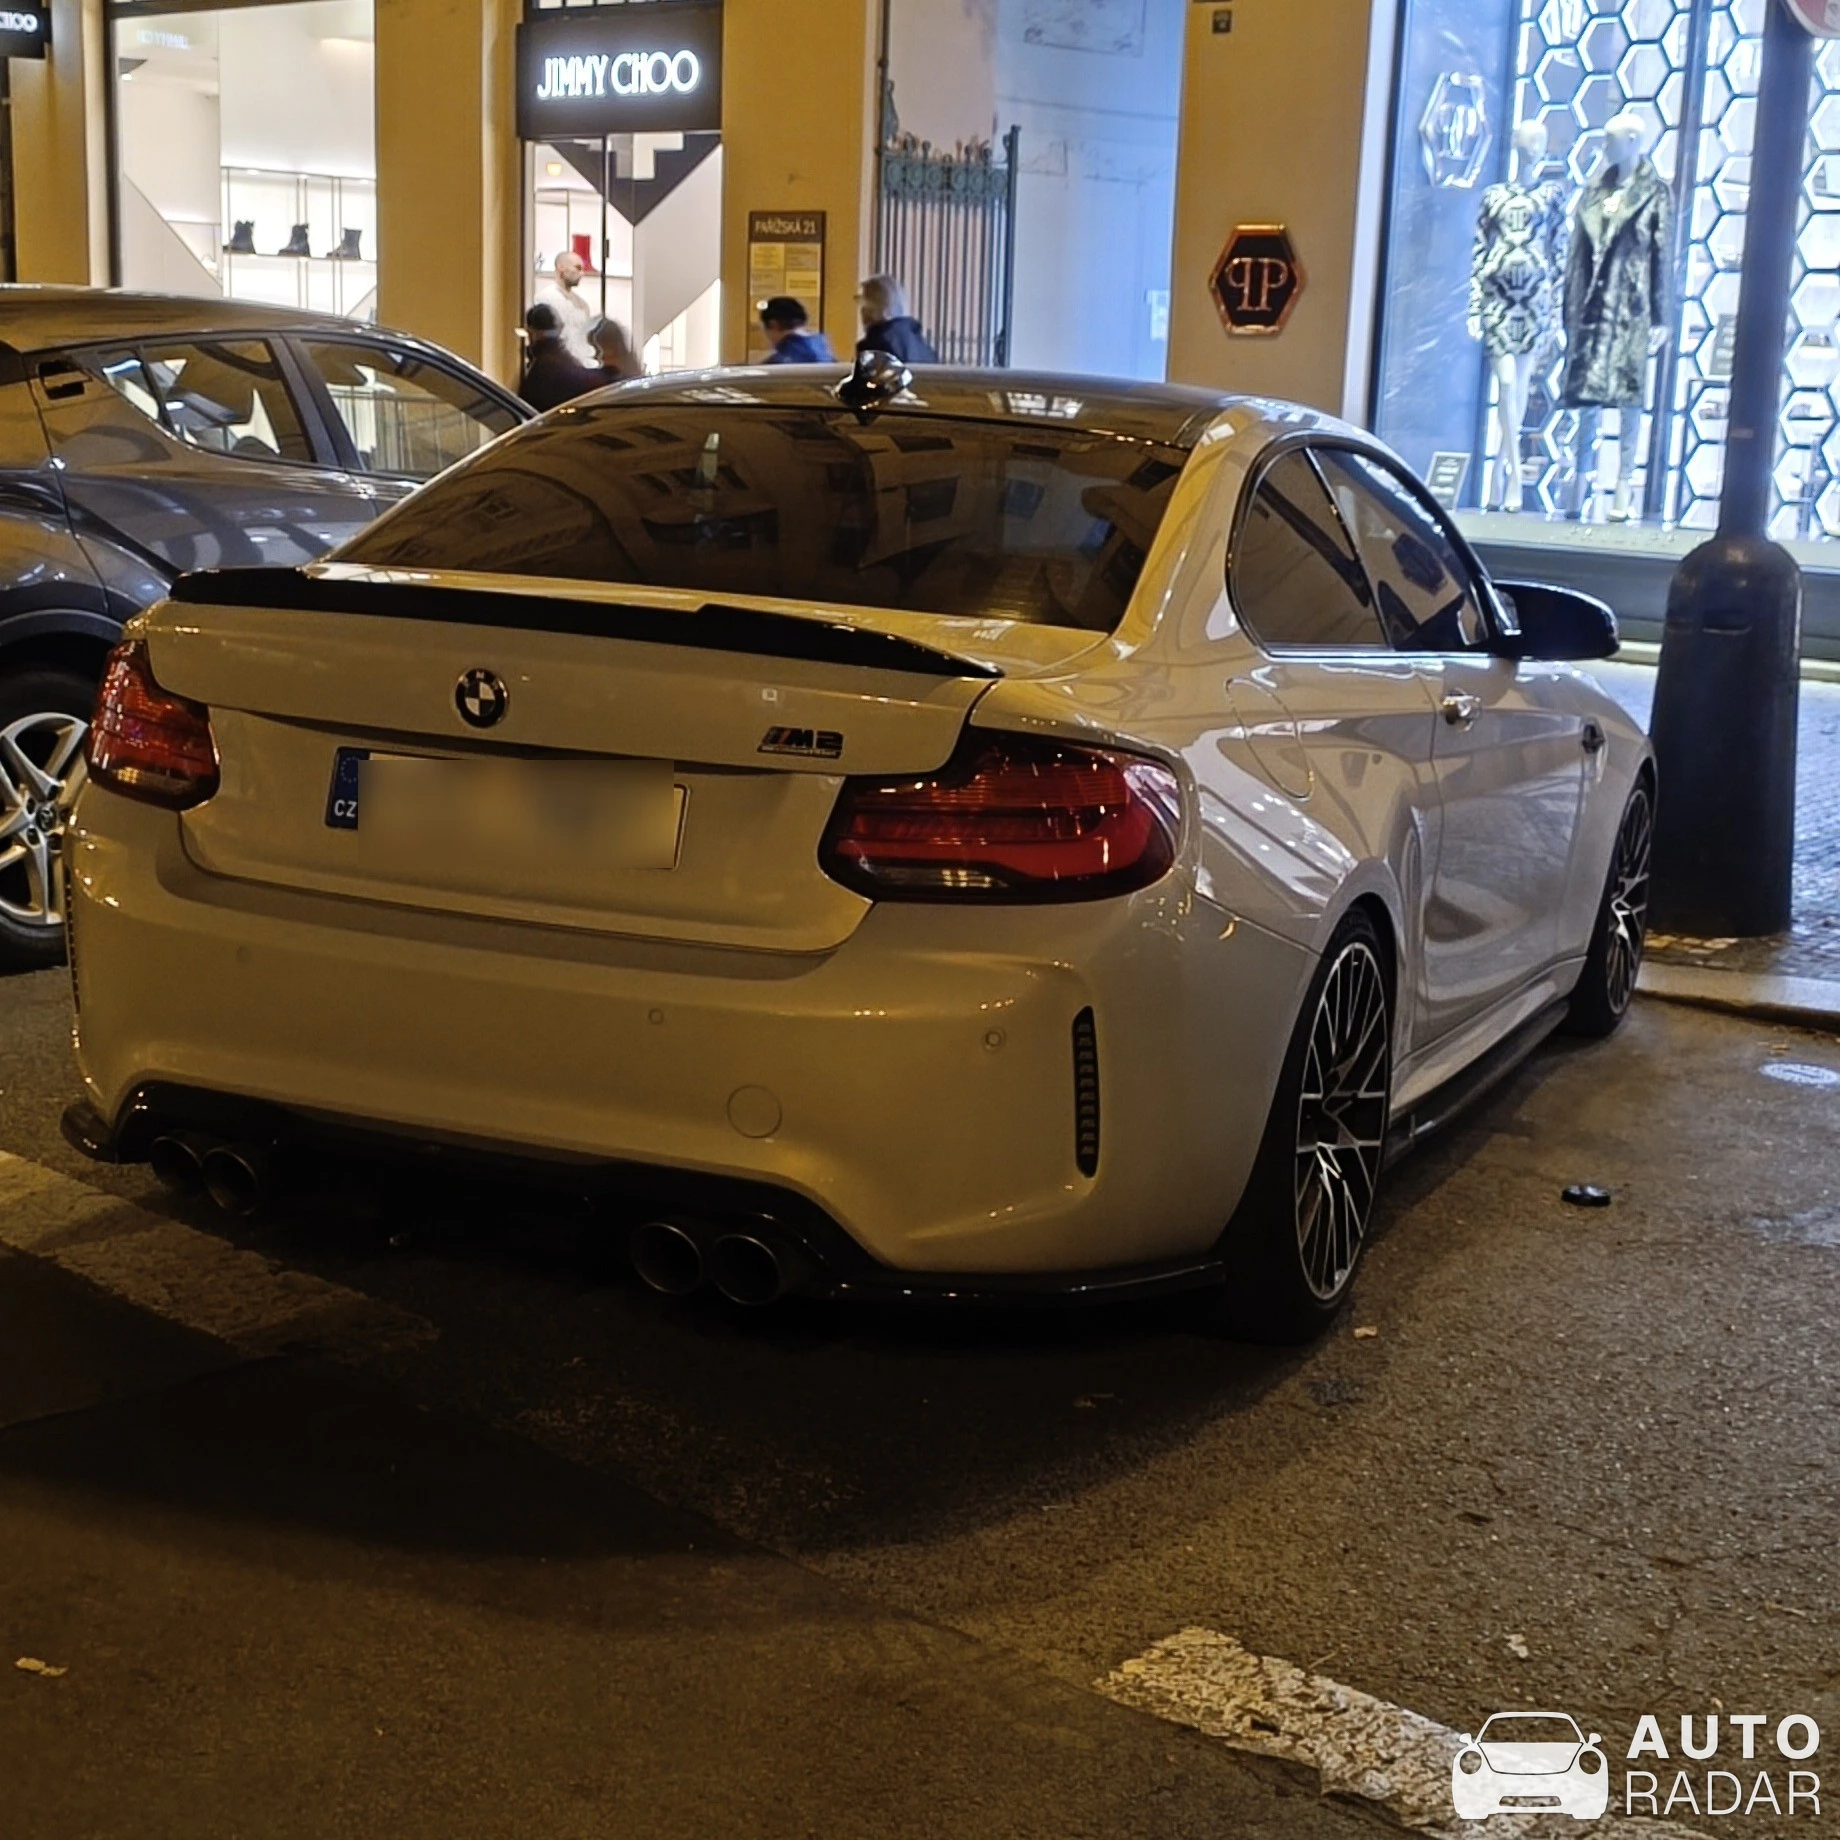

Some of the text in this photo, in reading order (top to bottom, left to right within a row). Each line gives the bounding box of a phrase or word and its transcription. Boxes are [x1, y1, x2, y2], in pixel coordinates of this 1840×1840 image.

[537, 50, 699, 98] JIMMY CHOO
[803, 220, 816, 234] 21
[333, 799, 358, 818] CZ
